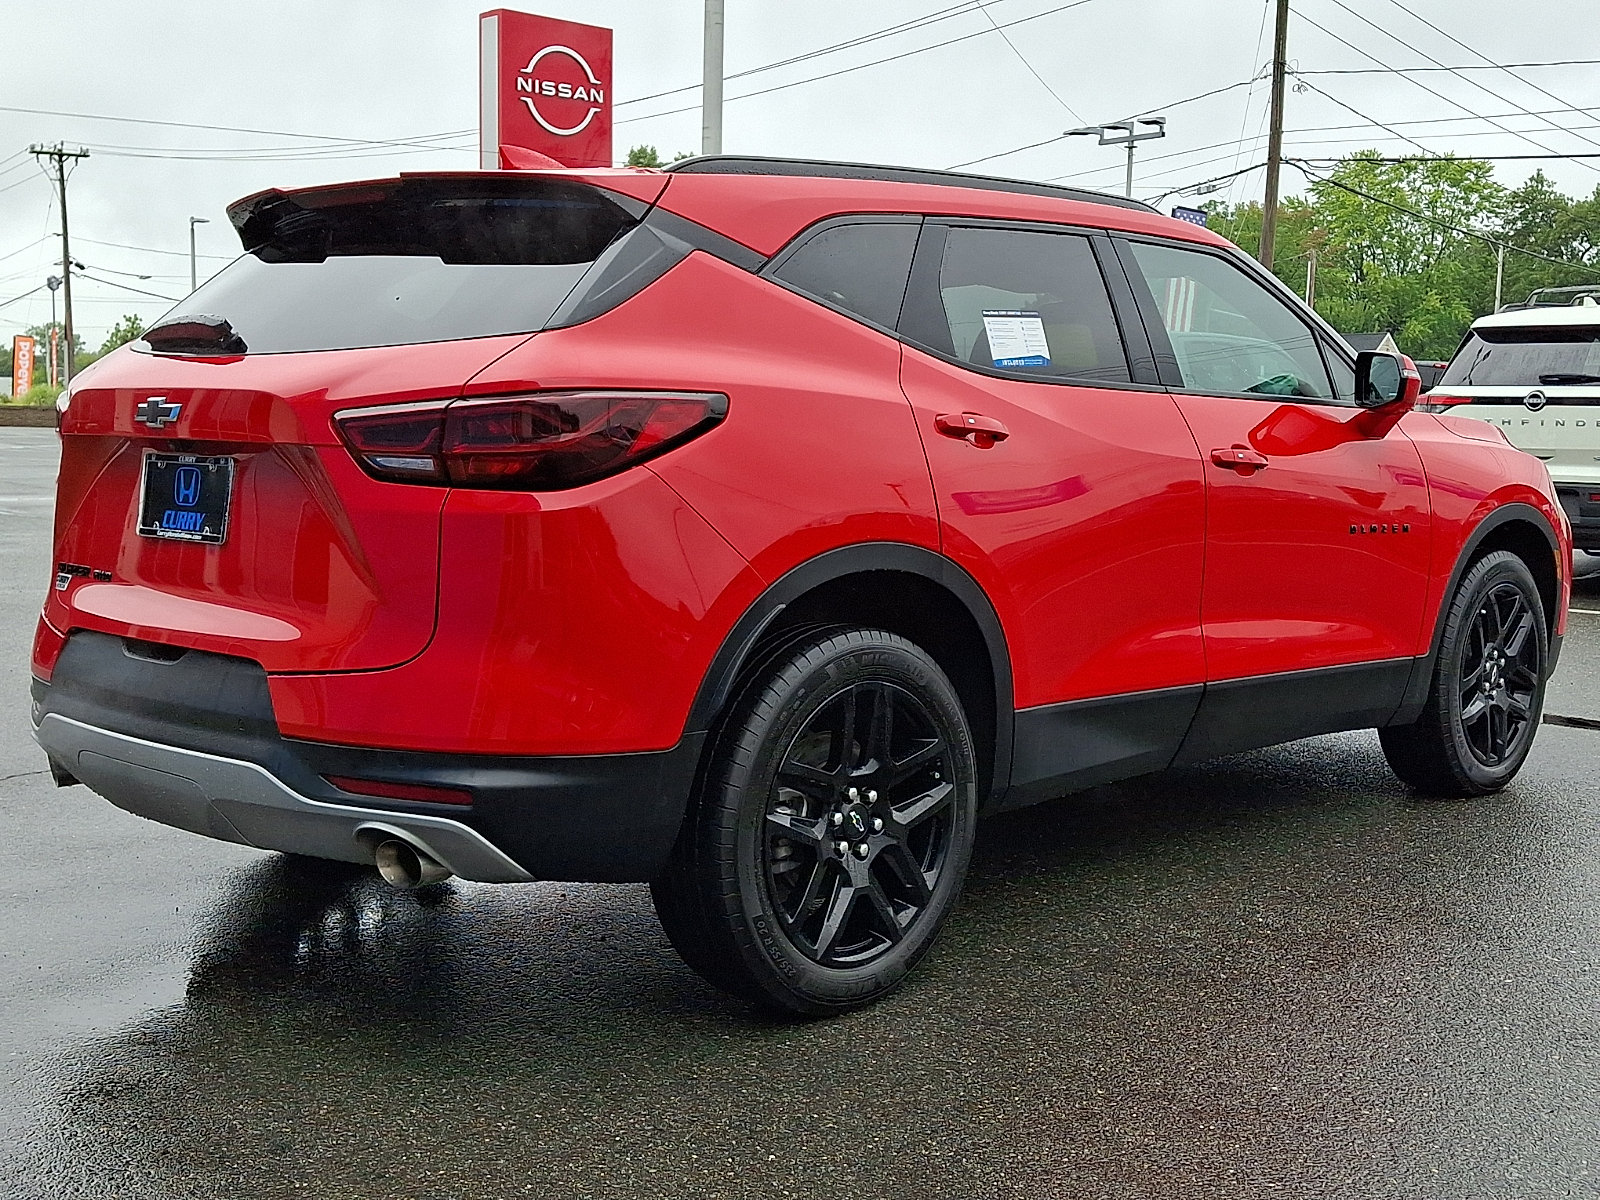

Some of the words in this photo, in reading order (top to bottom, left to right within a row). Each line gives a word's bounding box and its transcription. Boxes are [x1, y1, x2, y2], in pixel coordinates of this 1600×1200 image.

[517, 76, 604, 104] NISSAN
[162, 510, 206, 531] CURRY
[1349, 523, 1411, 534] BLAZER
[756, 920, 769, 935] 20
[763, 936, 775, 946] R
[769, 946, 798, 977] 235/55
